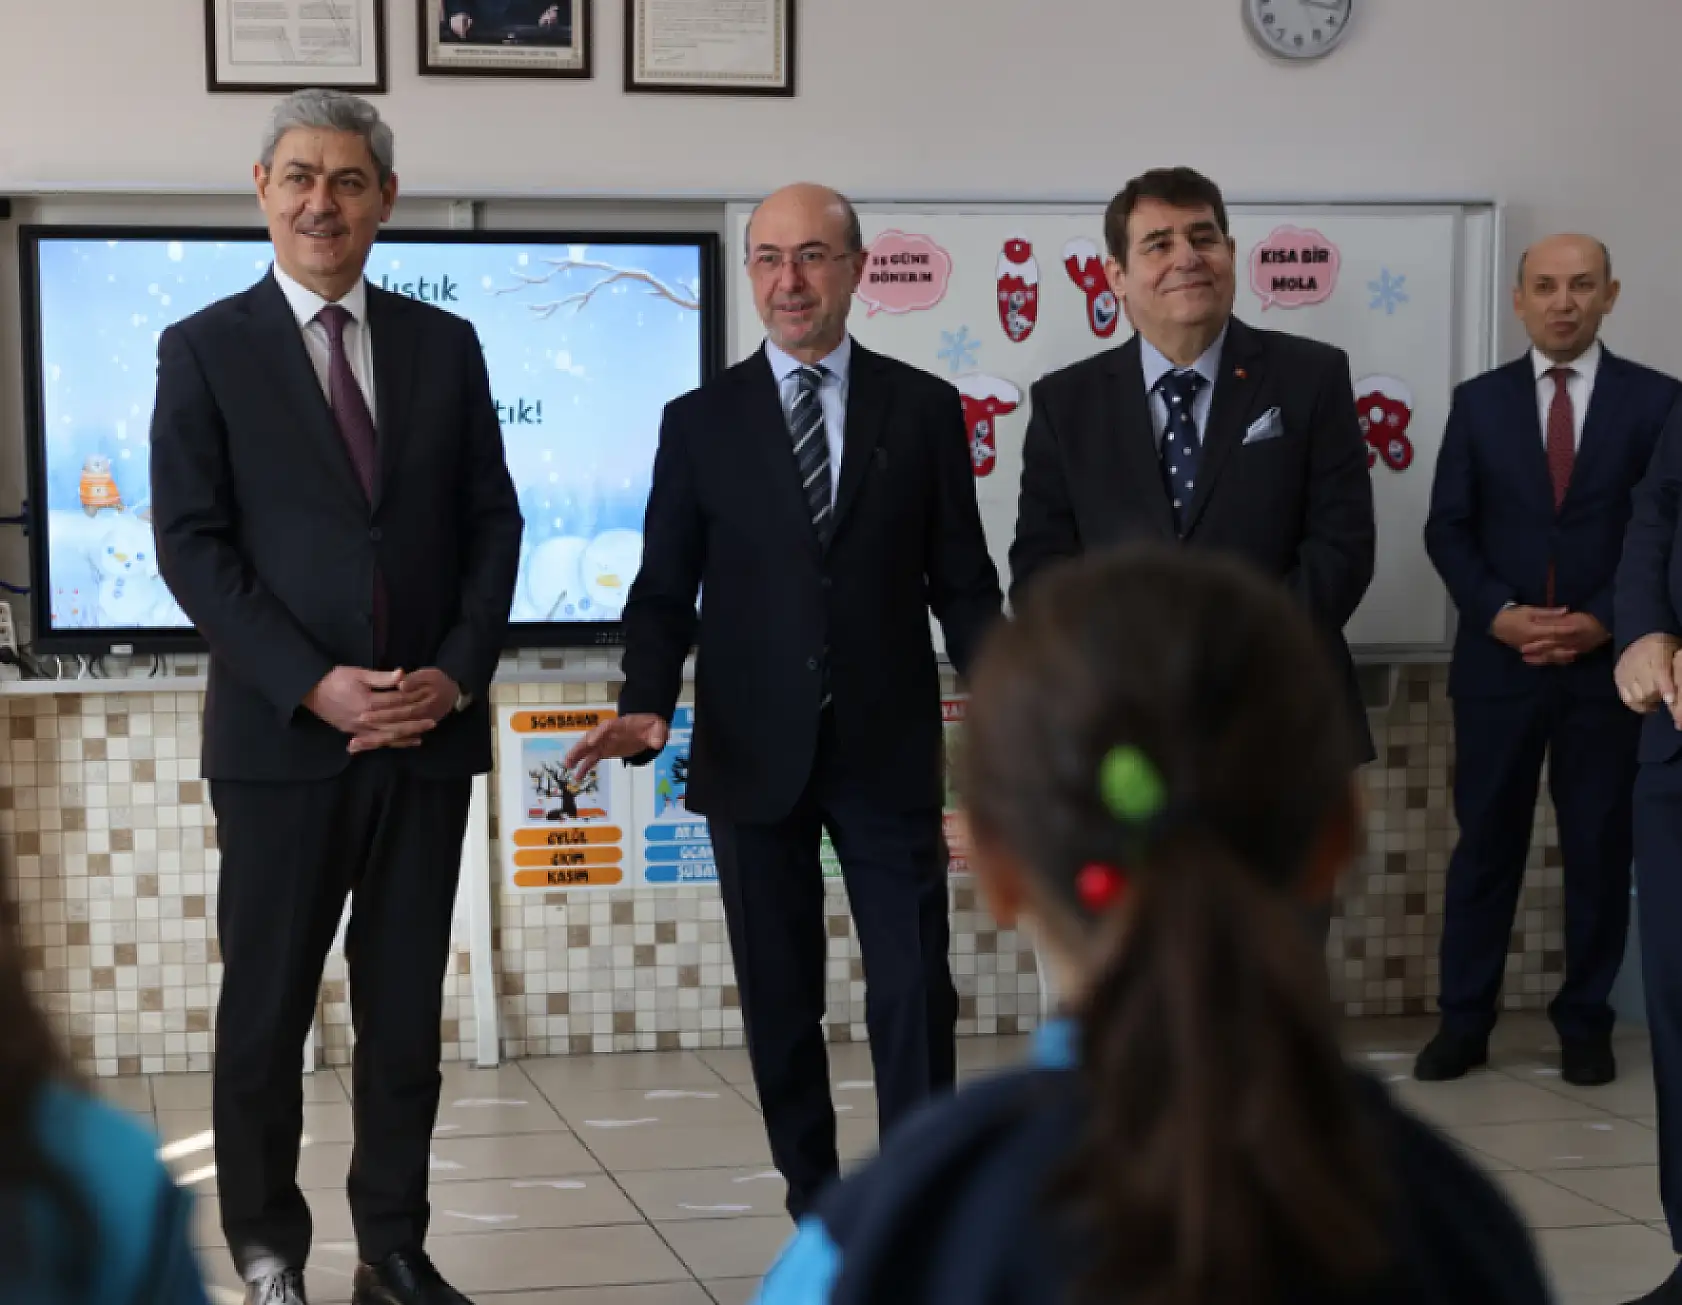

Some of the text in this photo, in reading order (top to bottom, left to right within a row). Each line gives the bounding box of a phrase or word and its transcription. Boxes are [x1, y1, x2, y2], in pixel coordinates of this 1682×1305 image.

[890, 252, 929, 265] GÜNE
[1260, 245, 1329, 264] KISA BİR
[1270, 274, 1318, 291] MOLA
[547, 869, 588, 885] KASIM
